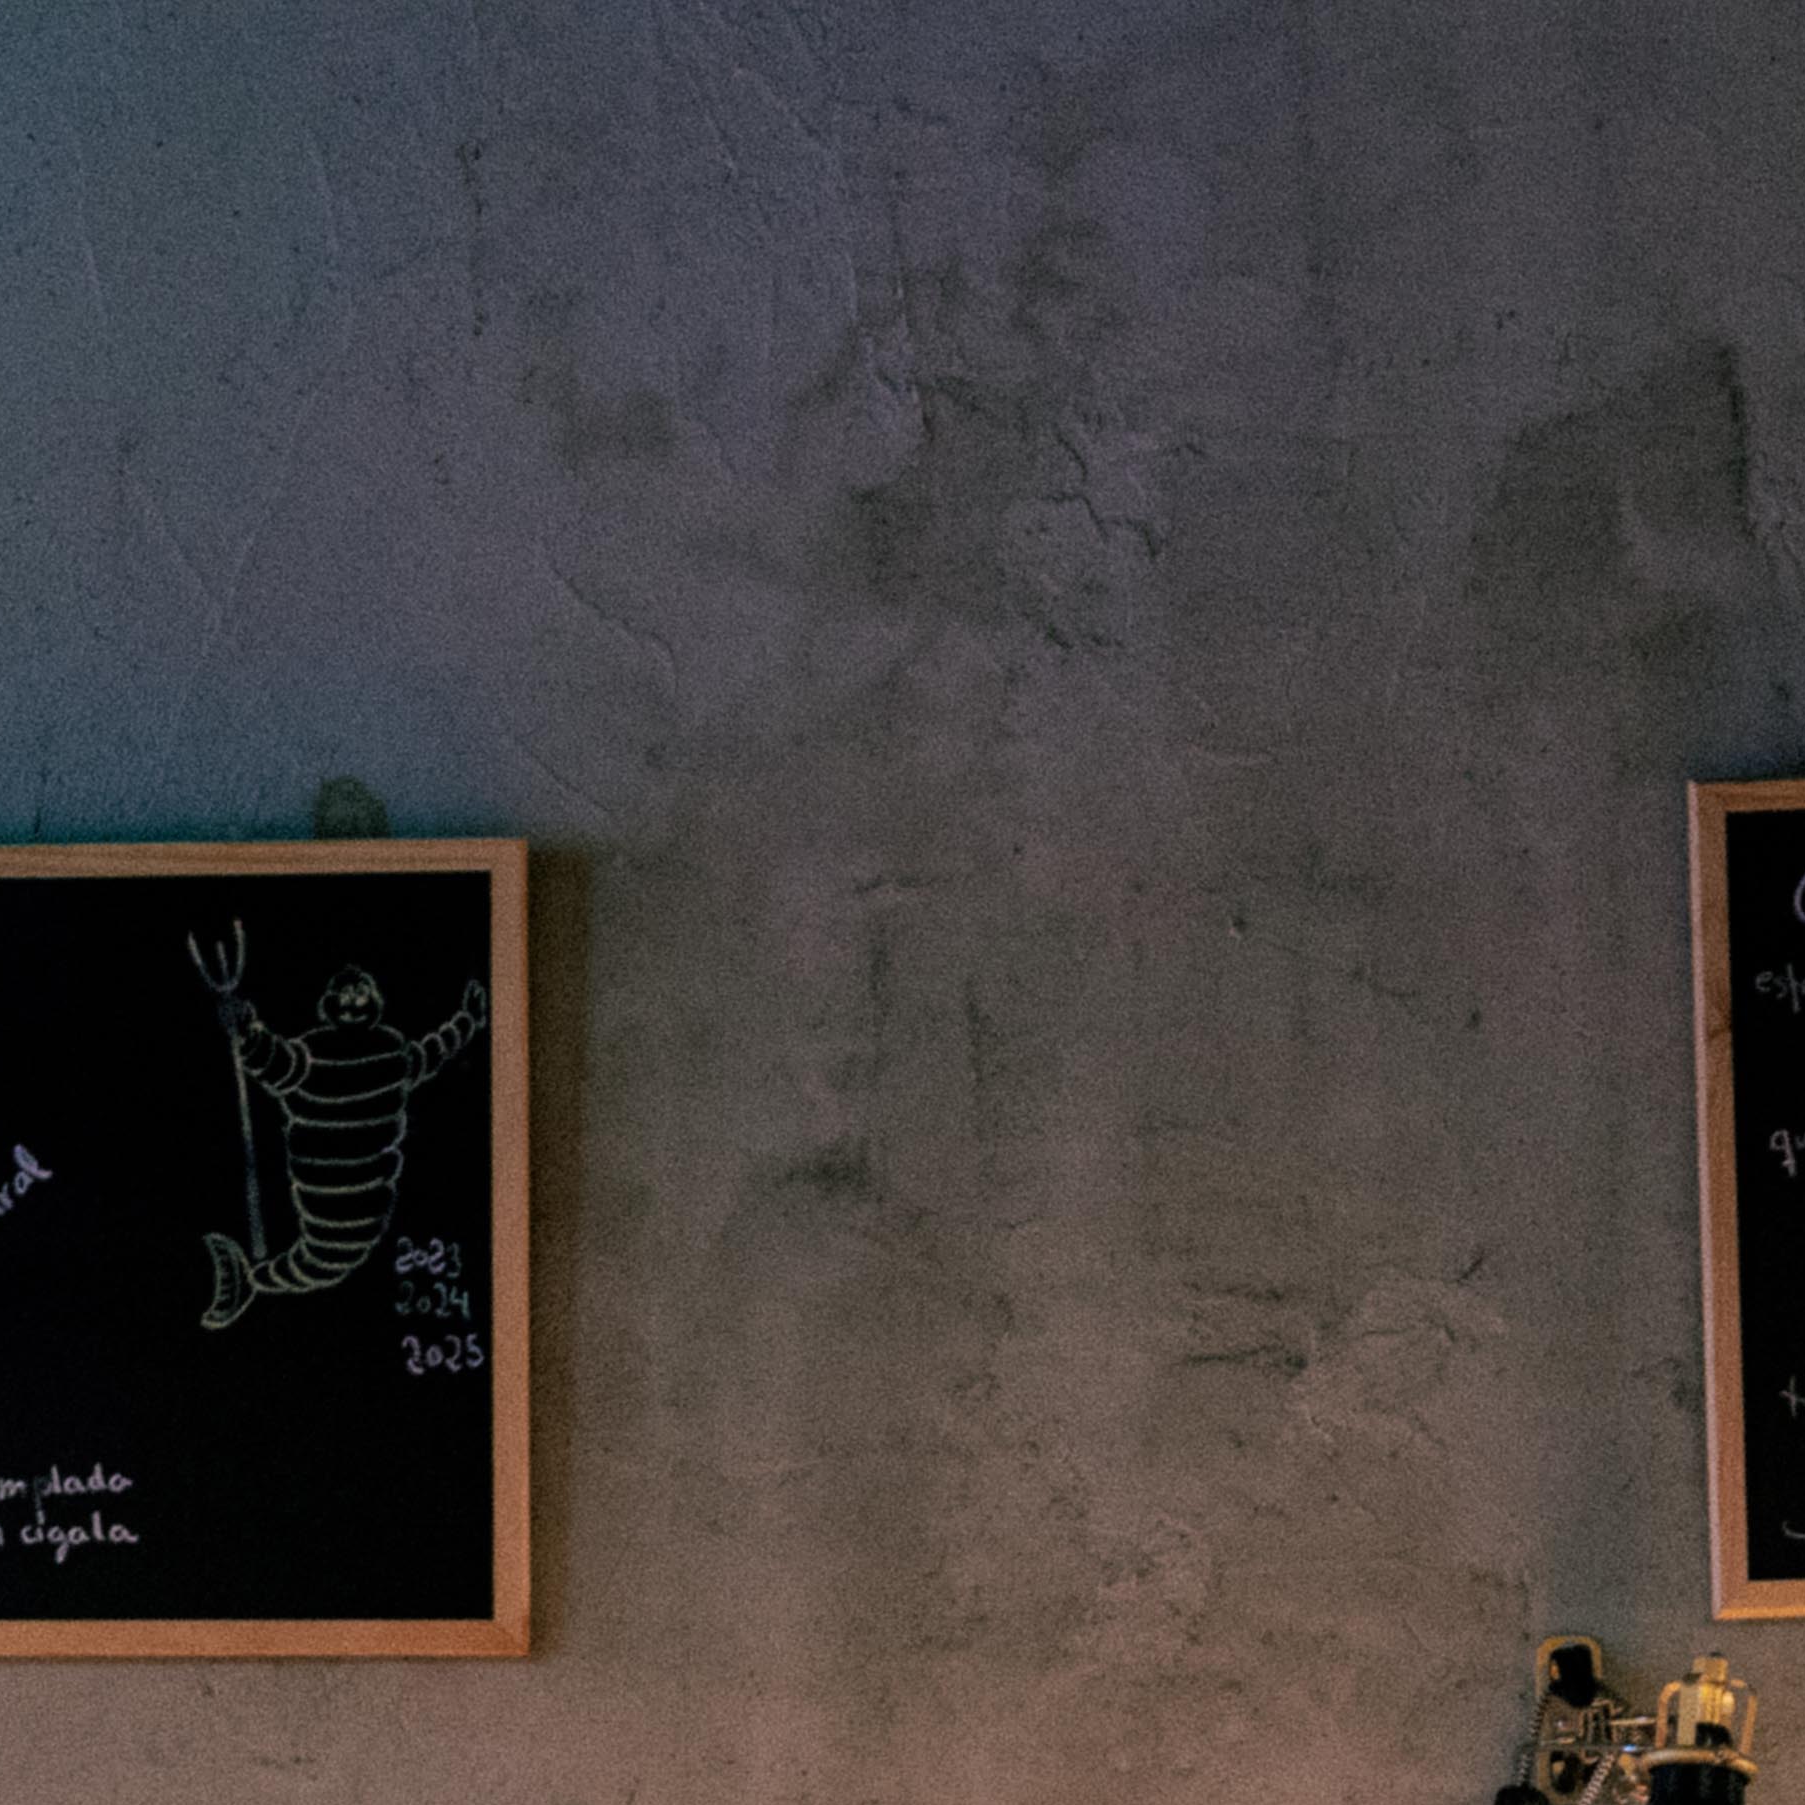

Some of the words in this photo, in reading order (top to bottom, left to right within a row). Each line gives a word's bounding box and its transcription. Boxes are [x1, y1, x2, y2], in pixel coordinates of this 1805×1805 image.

[393, 1235, 463, 1279] 2023
[393, 1280, 472, 1322] 2024
[400, 1333, 486, 1378] 2025
[19, 1510, 141, 1565] cigala
